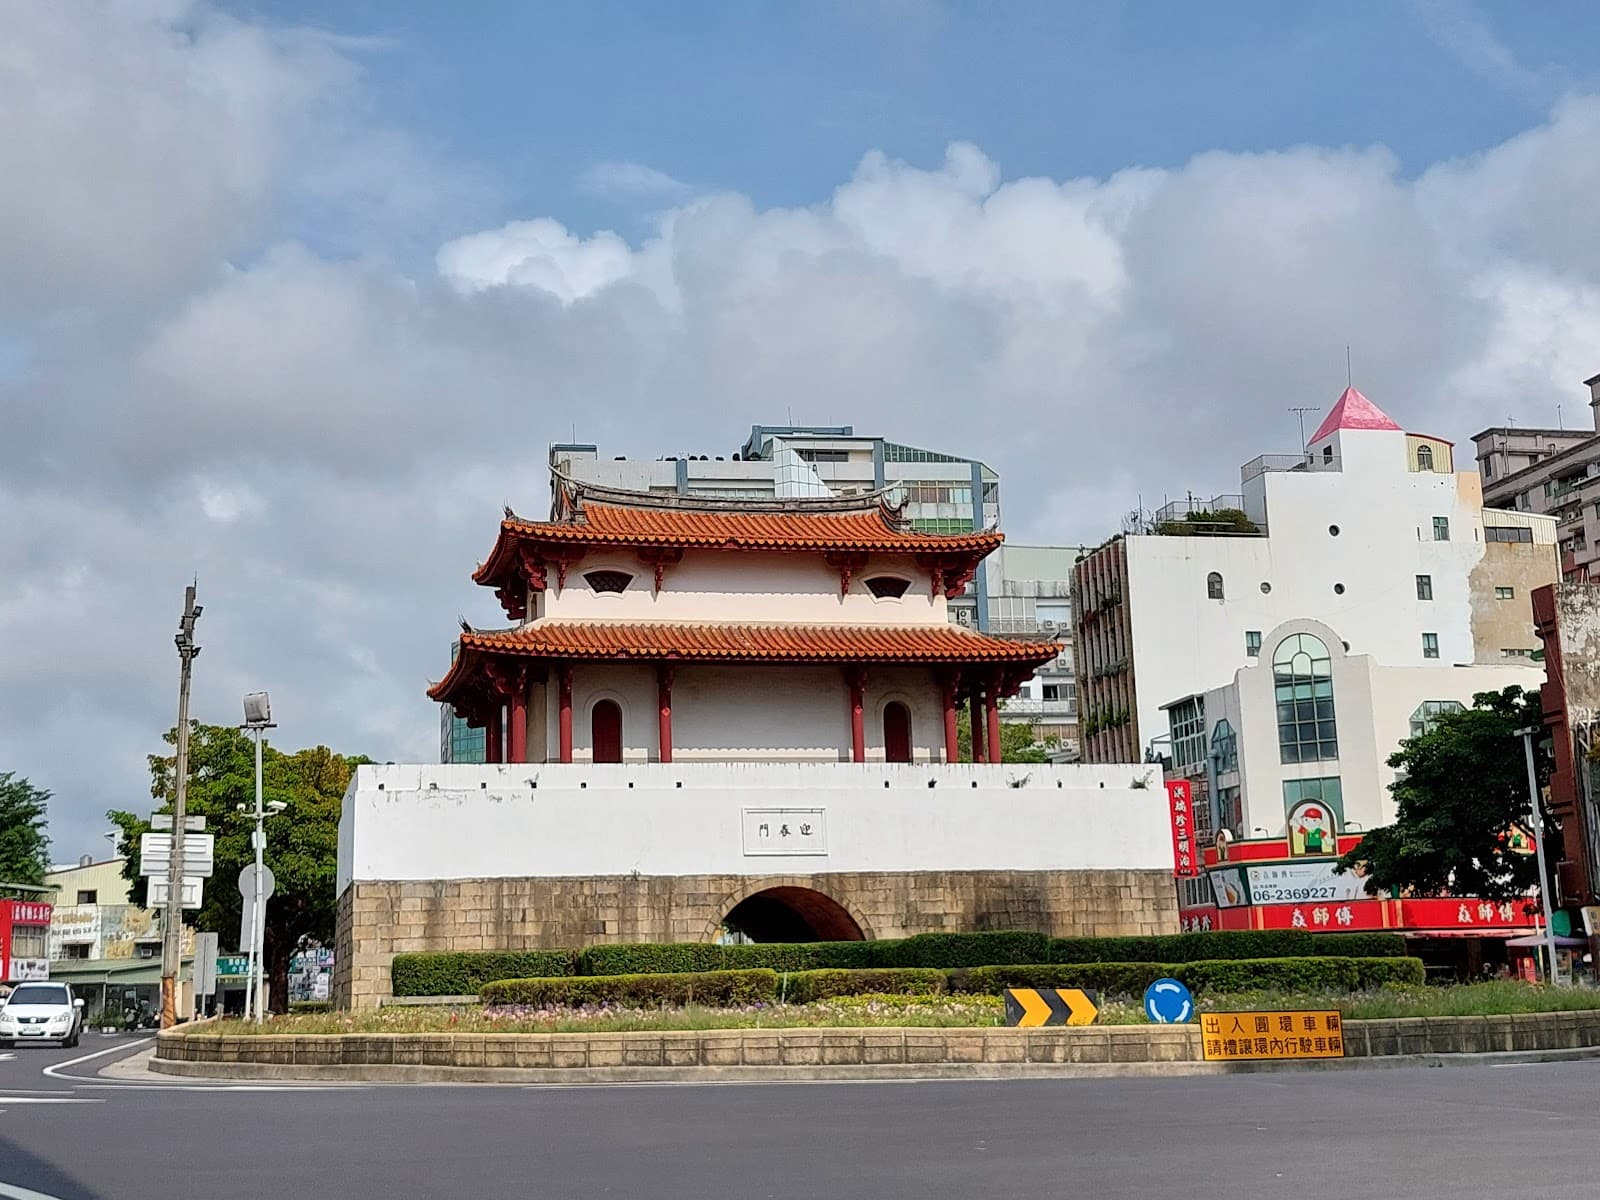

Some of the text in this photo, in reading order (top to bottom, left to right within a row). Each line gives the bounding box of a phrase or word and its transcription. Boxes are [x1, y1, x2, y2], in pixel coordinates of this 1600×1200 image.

[1253, 887, 1337, 901] 06-2369227
[1207, 1036, 1342, 1057] 請禮讓環內行駛車輛
